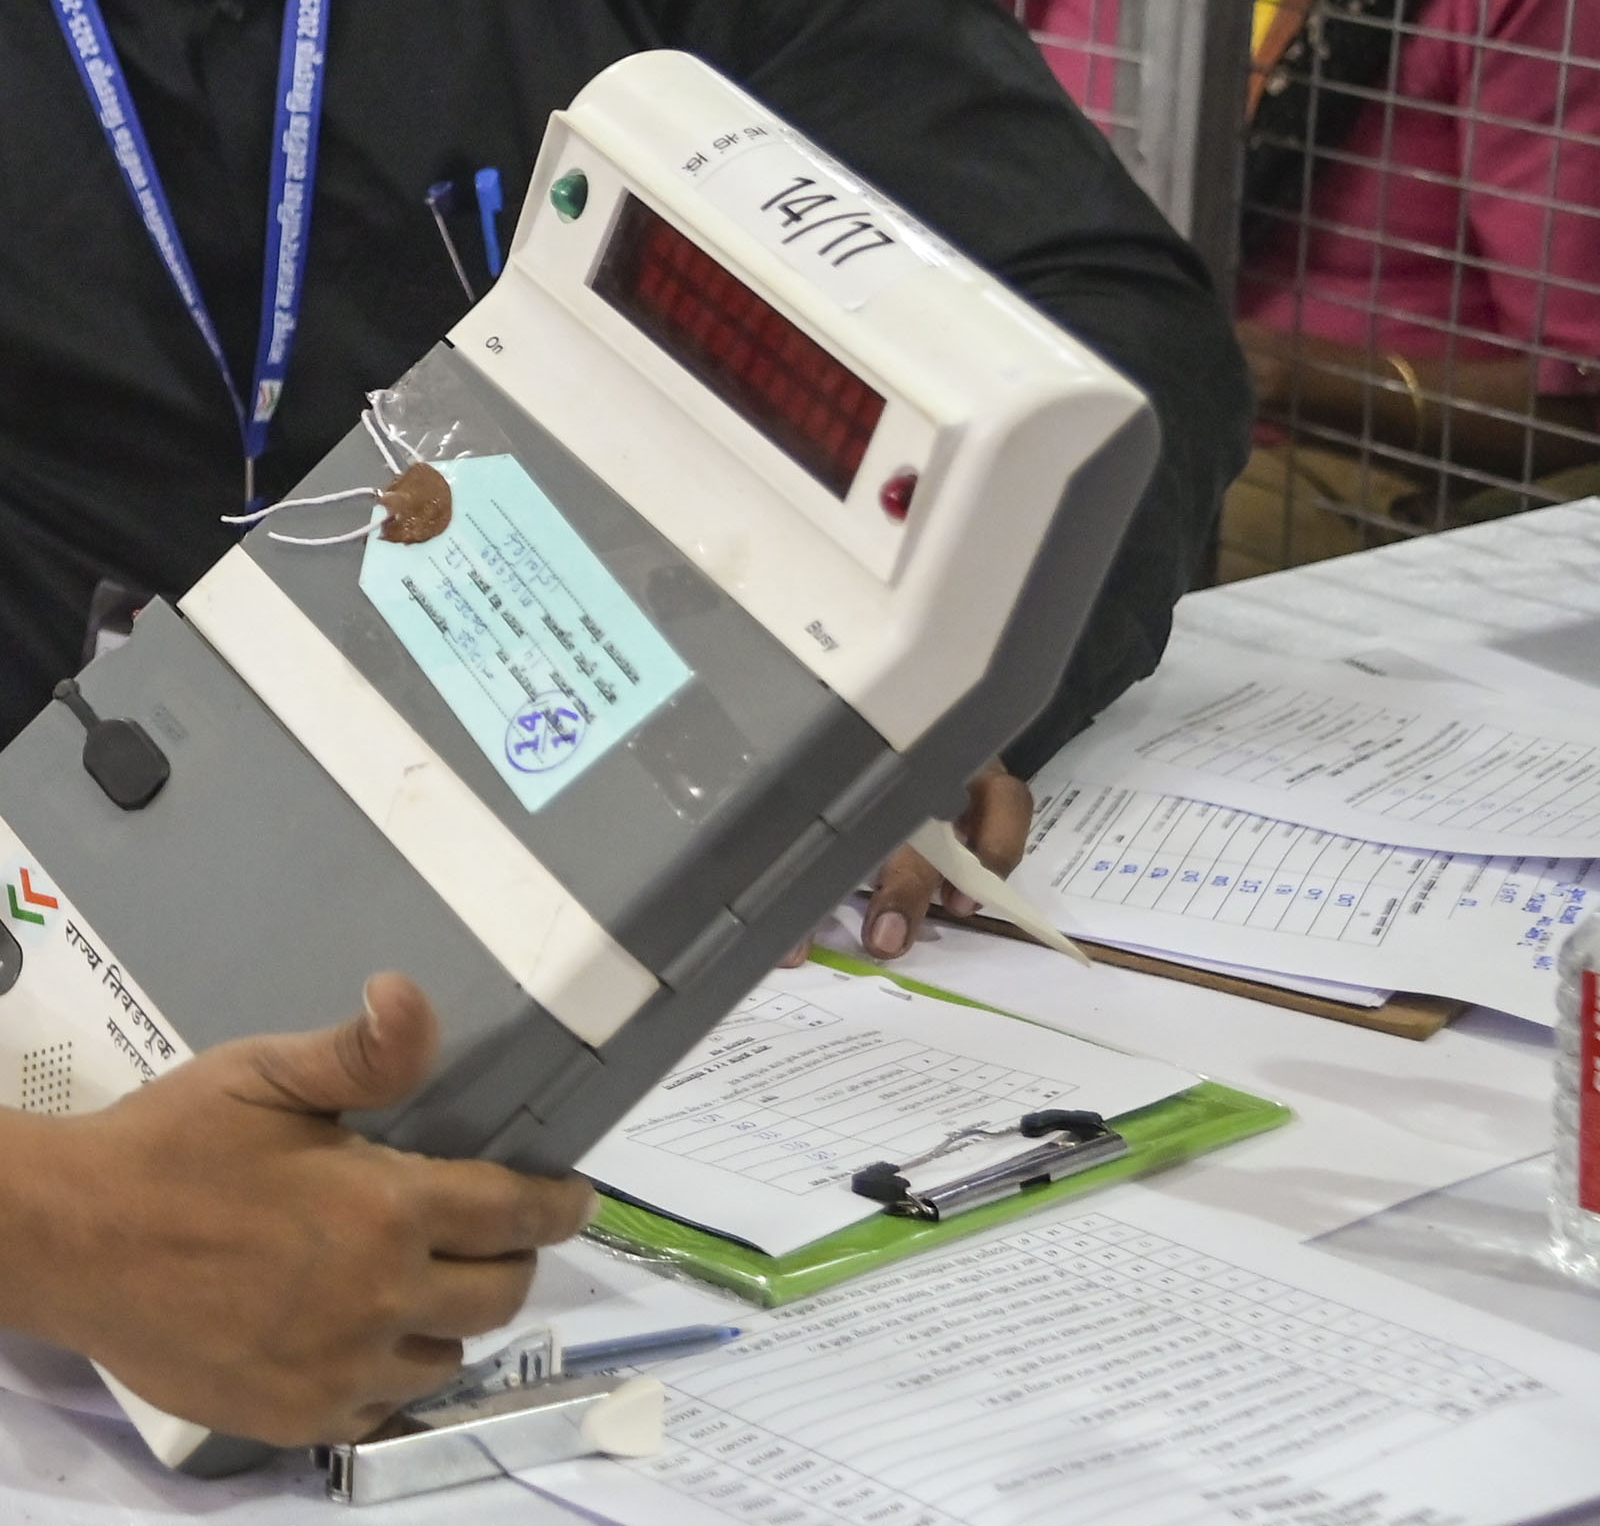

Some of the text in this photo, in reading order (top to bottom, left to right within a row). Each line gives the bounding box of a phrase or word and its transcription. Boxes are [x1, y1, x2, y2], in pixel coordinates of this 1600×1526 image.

[759, 176, 894, 268] 14/17
[484, 335, 505, 355] On
[64, 920, 177, 1061] राज्य निवडणूक
